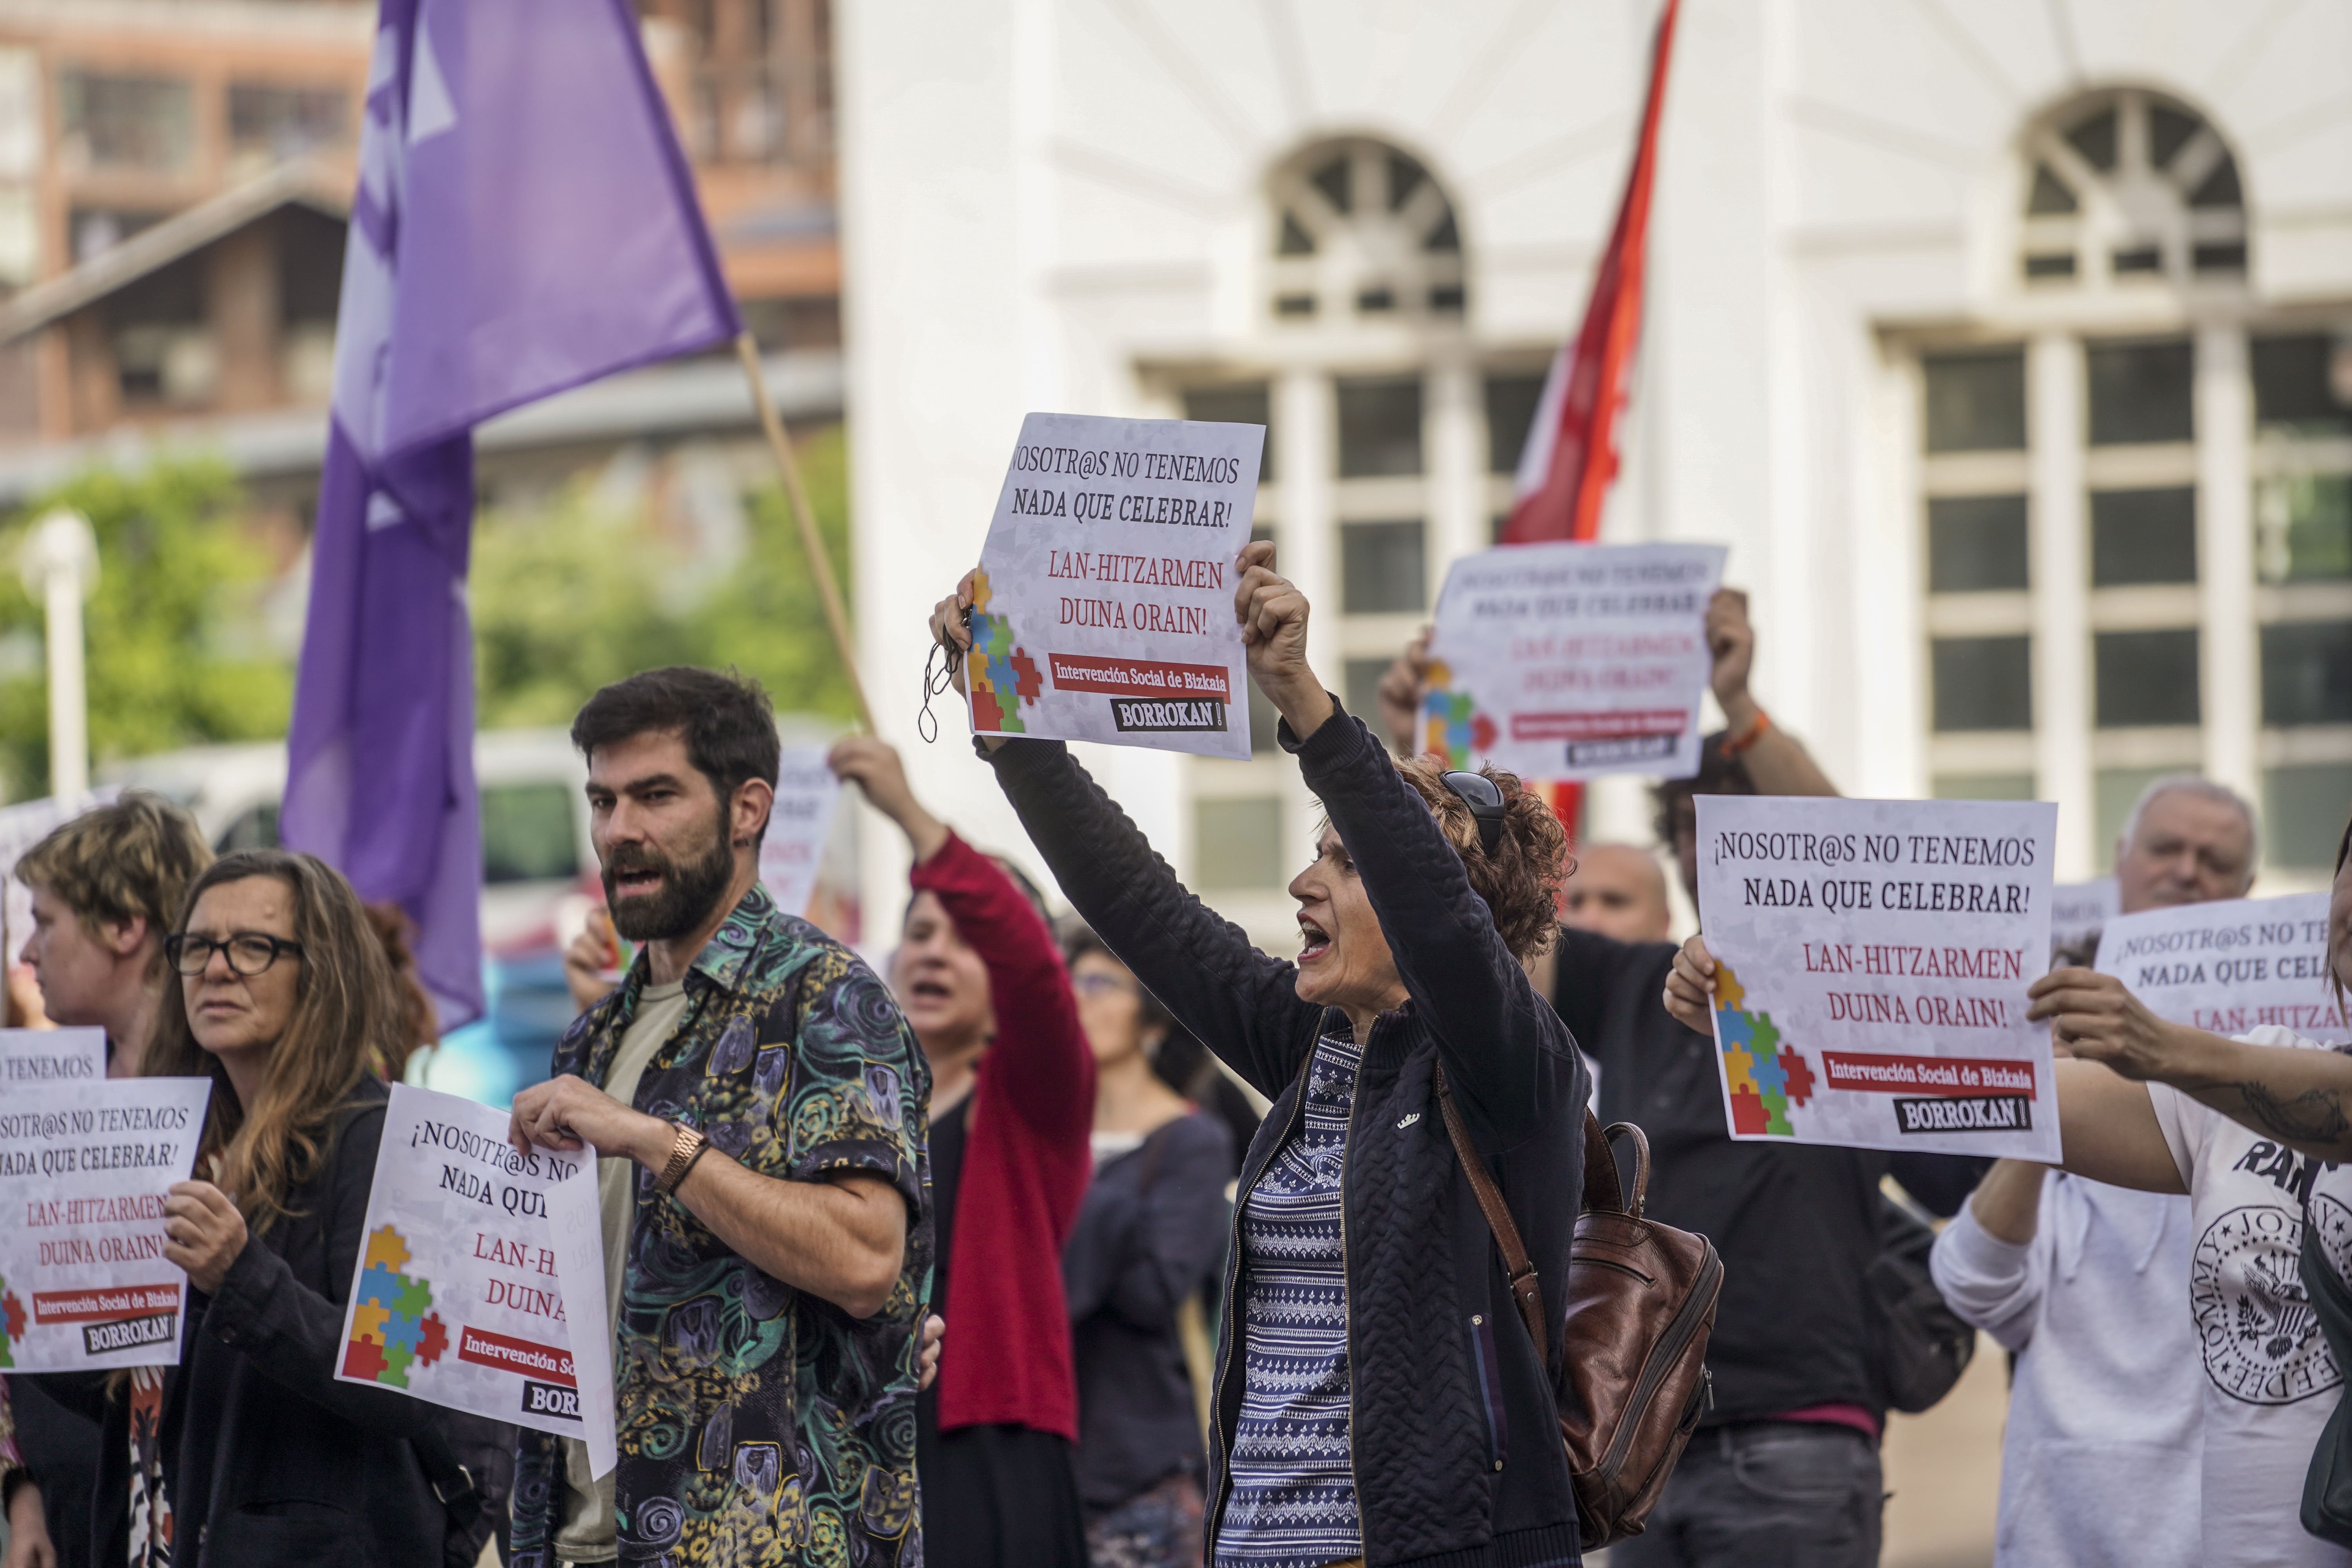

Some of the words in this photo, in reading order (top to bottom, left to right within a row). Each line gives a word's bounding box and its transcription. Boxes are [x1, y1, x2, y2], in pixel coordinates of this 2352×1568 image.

[1111, 452, 1139, 478] NO
[1145, 453, 1240, 484] TENEMOS
[1012, 488, 1066, 517] NADA
[1073, 492, 1114, 524] QUE
[1119, 495, 1232, 528] CELEBRAR!
[1048, 550, 1223, 590] LAN-HITZARMEN
[1060, 597, 1127, 629] DUINA
[1133, 603, 1207, 635] ORAIN!
[1054, 662, 1130, 684] Intervención
[1130, 668, 1166, 687] Social
[1167, 670, 1182, 688] de
[1183, 671, 1227, 692] Bizkaia
[1714, 831, 1856, 866] ¡NOSOTR@S
[1862, 835, 1900, 864] NO
[1908, 835, 2035, 866] TENEMOS
[1743, 878, 1814, 907] NADA
[1821, 880, 1872, 913] QUE
[1881, 880, 2030, 914] CELEBRAR!
[2259, 922, 2294, 945] NO
[1803, 943, 2023, 980] LAN-HITZARMEN
[2138, 963, 2207, 988] NADA
[2215, 958, 2267, 987] QUE
[1827, 992, 1910, 1024] DUINA
[1915, 997, 2007, 1028] ORAIN!
[6, 1054, 93, 1080] TENEMOS
[1829, 1059, 1916, 1083] Intervención
[1916, 1063, 1960, 1086] Social
[1961, 1066, 1979, 1086] de
[1980, 1067, 2032, 1090] Bizkaia
[71, 1109, 93, 1134] NO
[99, 1106, 188, 1132] TENEMOS
[42, 1148, 76, 1178] QUE
[81, 1143, 178, 1171] CELEBRAR!
[412, 1120, 540, 1176] ¡NOSOTR@S
[439, 1164, 494, 1206] NADA
[40, 1239, 96, 1266] DUINA
[473, 1232, 558, 1278] LAN-H
[36, 1295, 98, 1315] Intervención
[98, 1292, 129, 1312] Social
[132, 1292, 145, 1308] de
[145, 1290, 177, 1307] Bizkaia
[2194, 1231, 2229, 1368] TOMMY
[465, 1334, 557, 1372] Intervención
